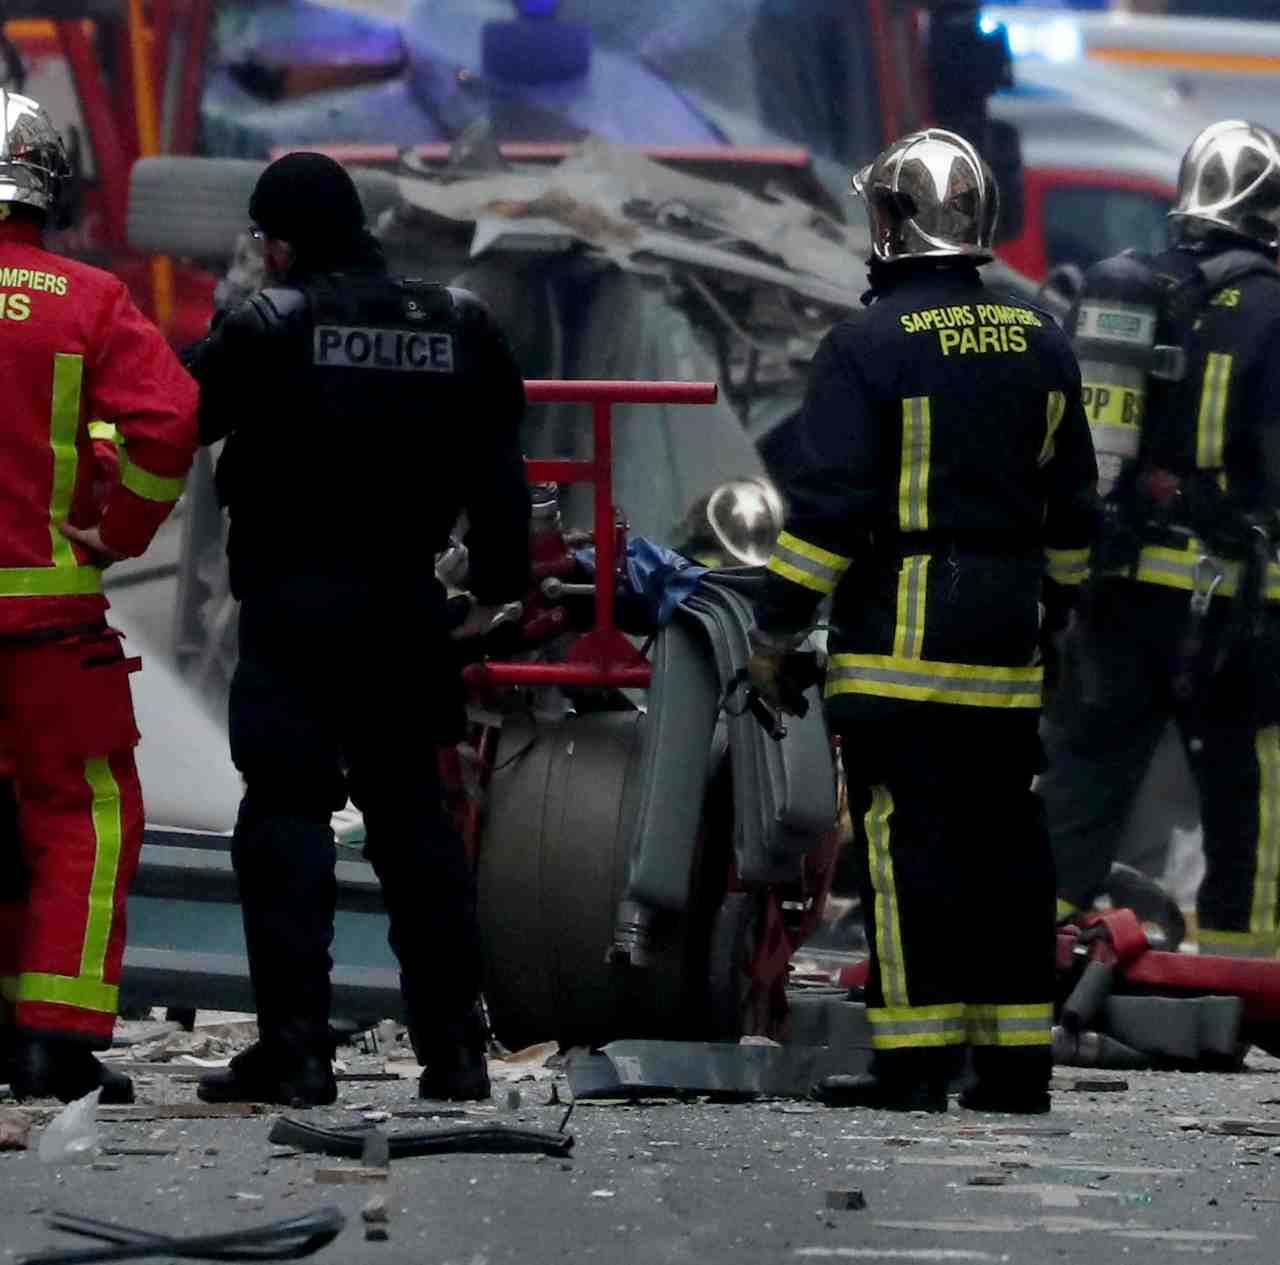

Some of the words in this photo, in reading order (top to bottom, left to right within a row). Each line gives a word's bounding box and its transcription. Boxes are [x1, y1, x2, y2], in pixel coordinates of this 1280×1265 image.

[901, 304, 976, 334] SAPEURS
[976, 304, 1042, 327] POMPIERS
[320, 329, 450, 367] POLICE
[938, 325, 1028, 357] PARIS
